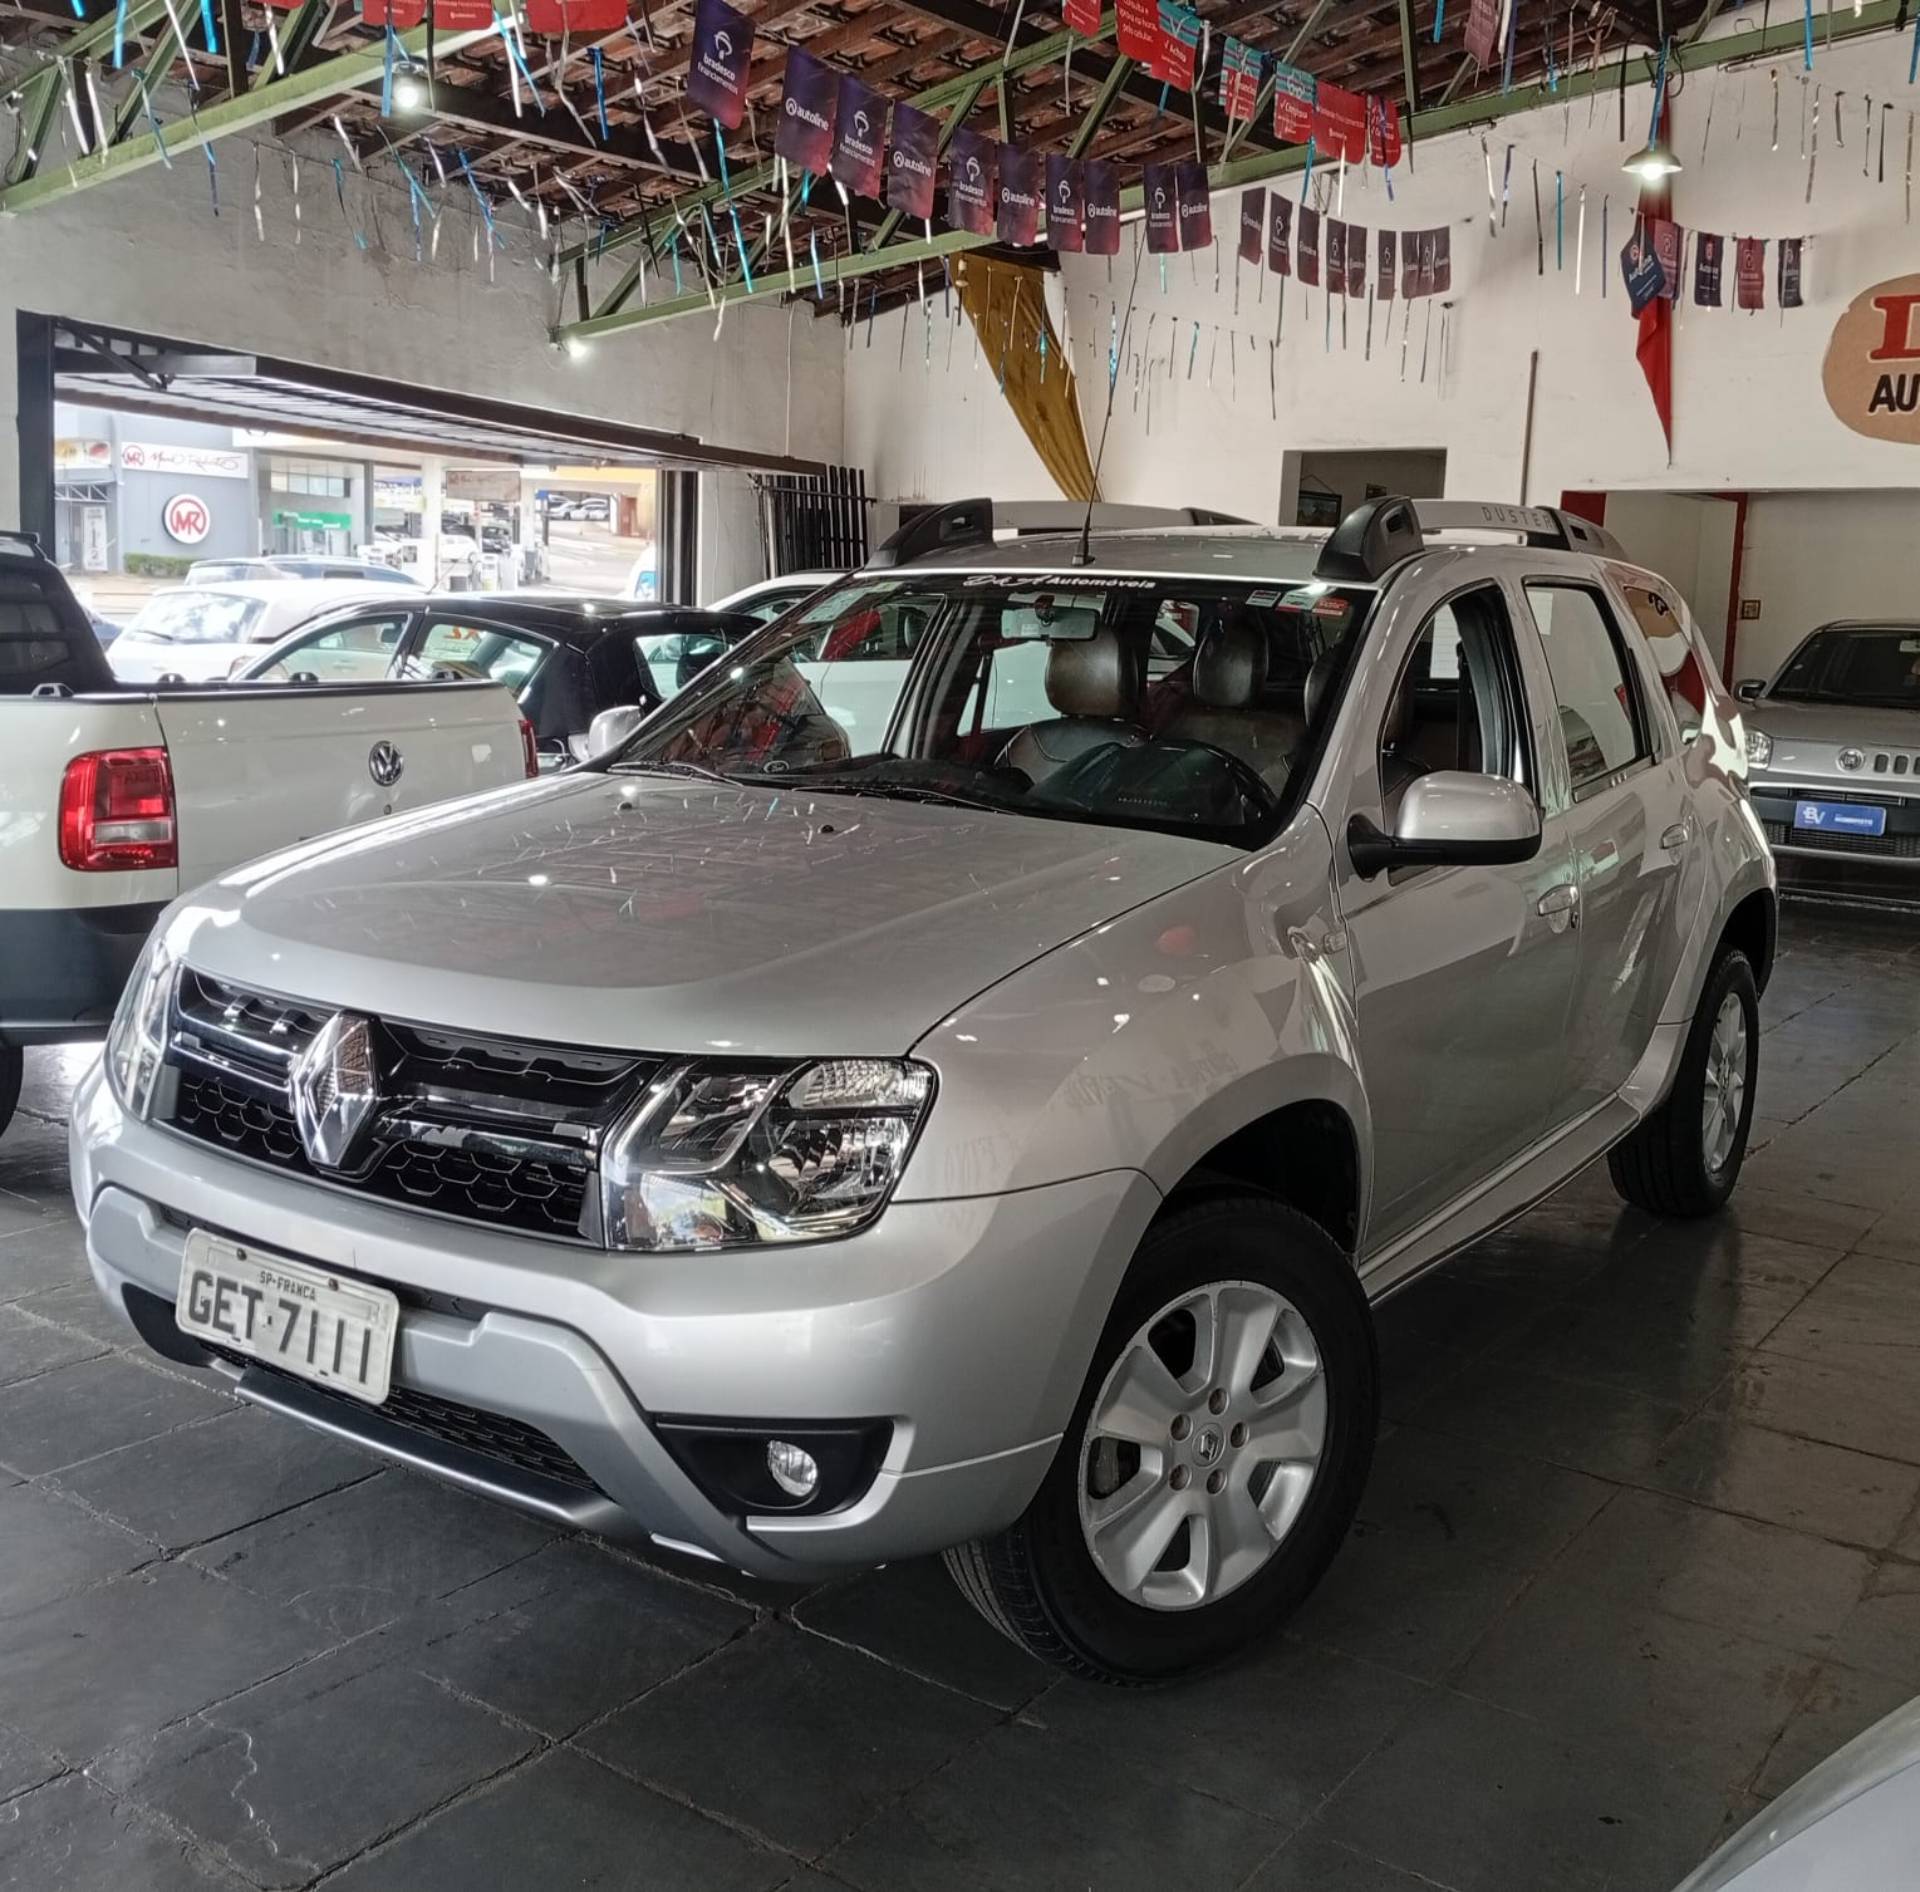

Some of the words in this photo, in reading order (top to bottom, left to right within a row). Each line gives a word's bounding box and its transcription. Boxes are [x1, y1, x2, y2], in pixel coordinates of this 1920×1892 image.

[703, 53, 736, 81] bradesco
[797, 106, 829, 131] autoline
[844, 134, 873, 155] bradesco
[904, 158, 932, 177] autoline
[1010, 193, 1035, 207] autoline
[1481, 506, 1553, 528] DUSTER
[259, 1270, 316, 1300] SP-FRANCA
